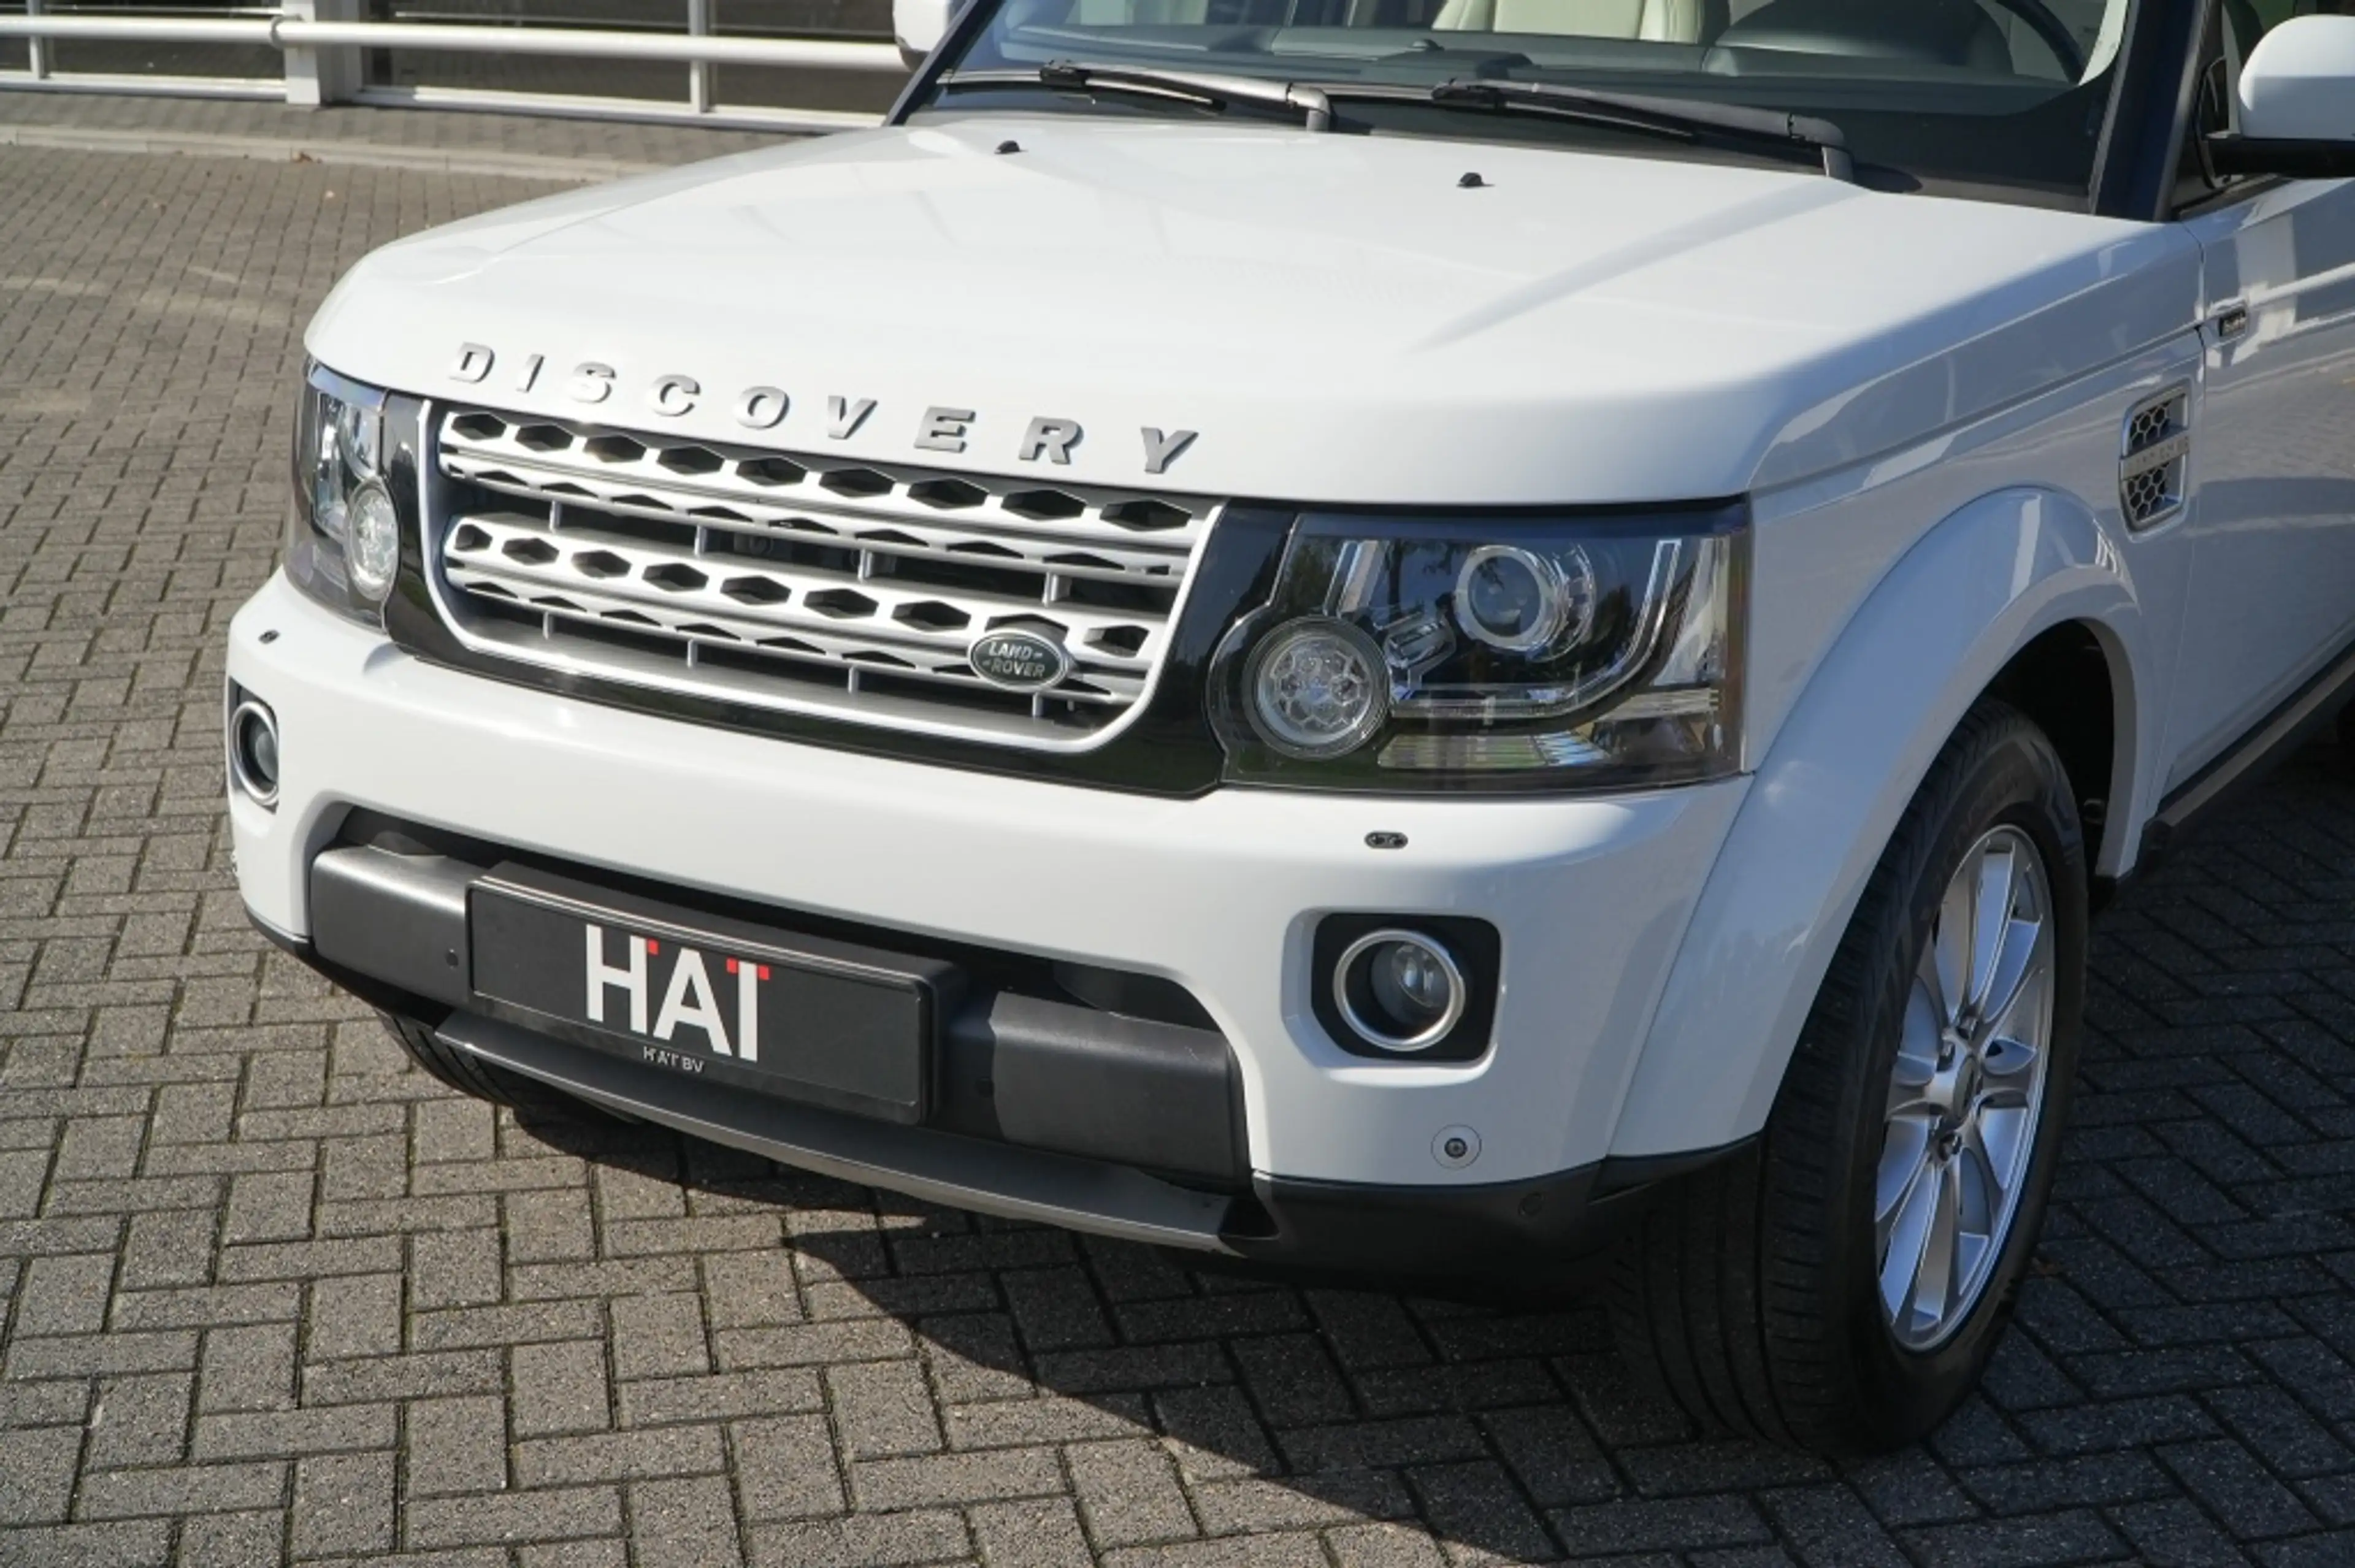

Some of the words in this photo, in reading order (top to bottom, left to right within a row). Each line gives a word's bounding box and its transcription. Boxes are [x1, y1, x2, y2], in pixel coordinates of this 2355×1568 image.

[448, 342, 1199, 474] DISCOVERY
[586, 924, 769, 1062] HAT
[682, 1056, 705, 1073] BV
